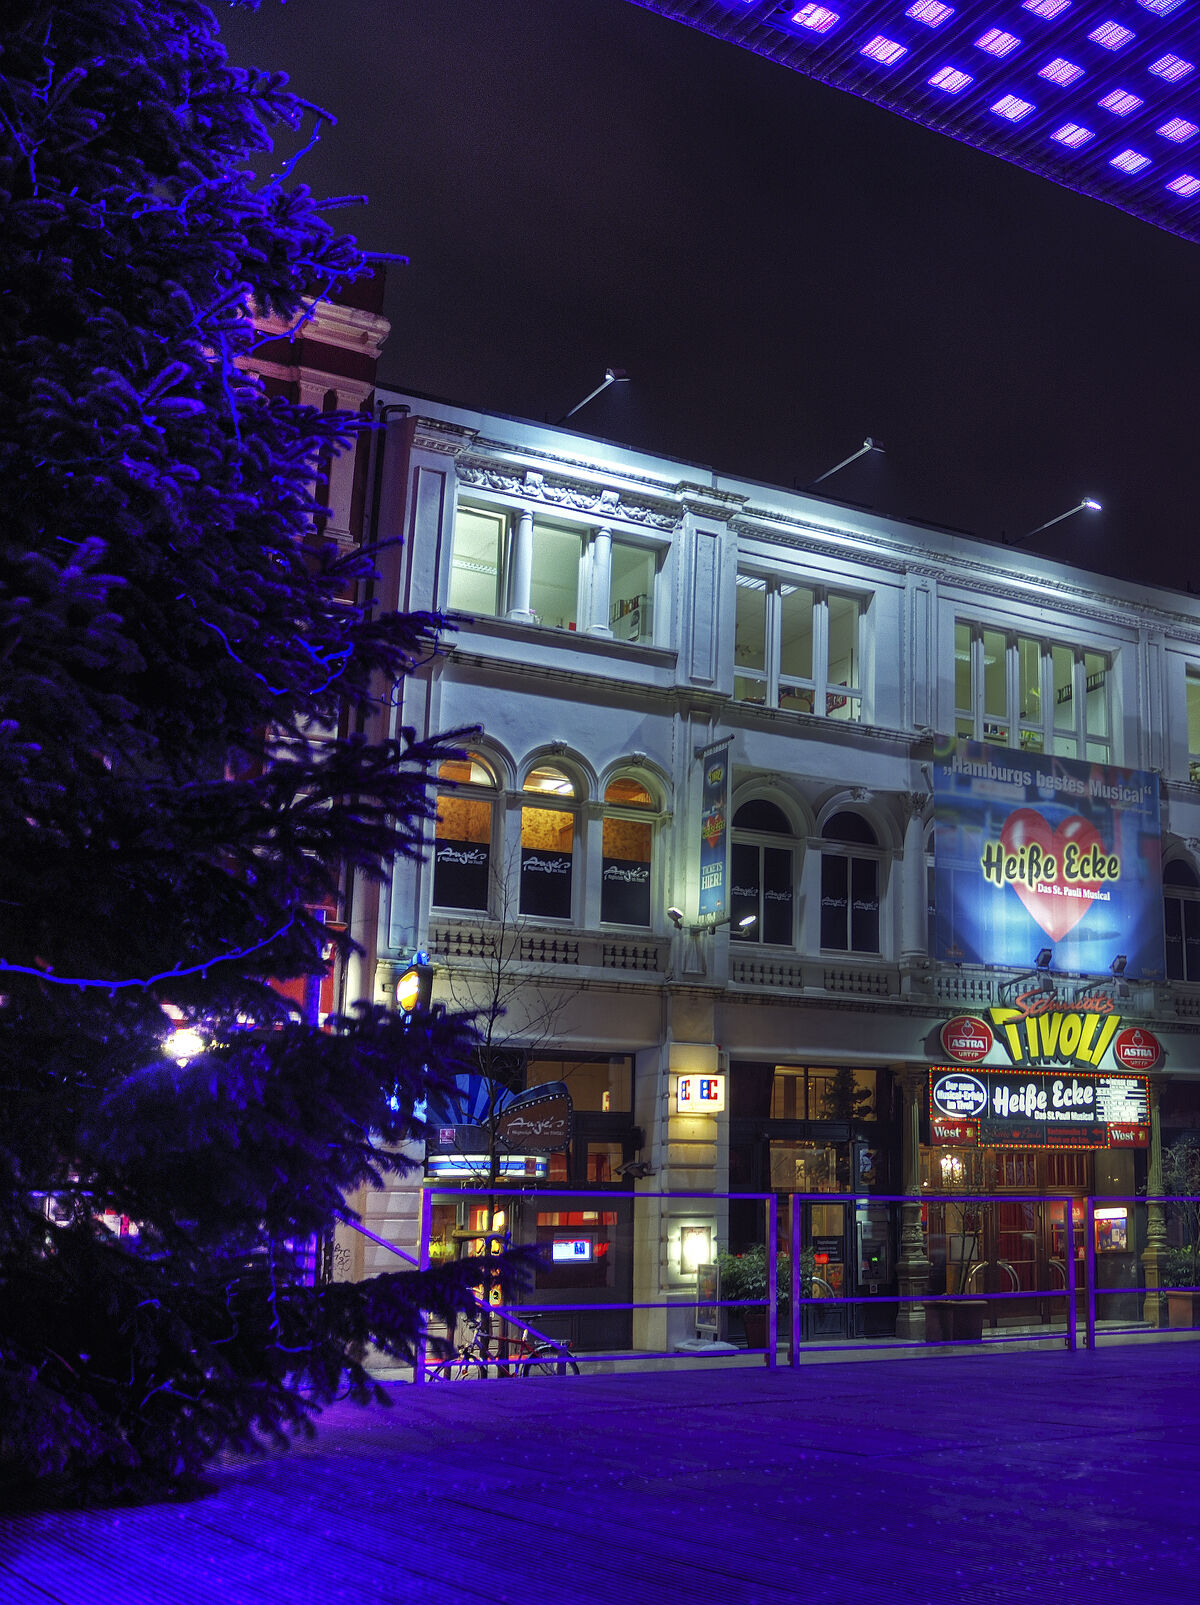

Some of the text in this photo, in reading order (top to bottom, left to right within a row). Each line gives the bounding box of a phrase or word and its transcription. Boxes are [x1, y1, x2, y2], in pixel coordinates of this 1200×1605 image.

[1036, 770, 1085, 794] bestes
[981, 843, 1120, 888] Heiße Ecke
[701, 871, 723, 890] HIER!
[1037, 883, 1111, 901] Das St. Pauli Musical
[951, 1038, 985, 1049] ASTRA
[989, 1007, 1122, 1066] TIVOLI
[1123, 1047, 1153, 1058] ASTRA
[992, 1083, 1048, 1118] Heiße
[1052, 1078, 1094, 1108] Ecke
[933, 1126, 961, 1138] West
[1111, 1129, 1135, 1141] West
